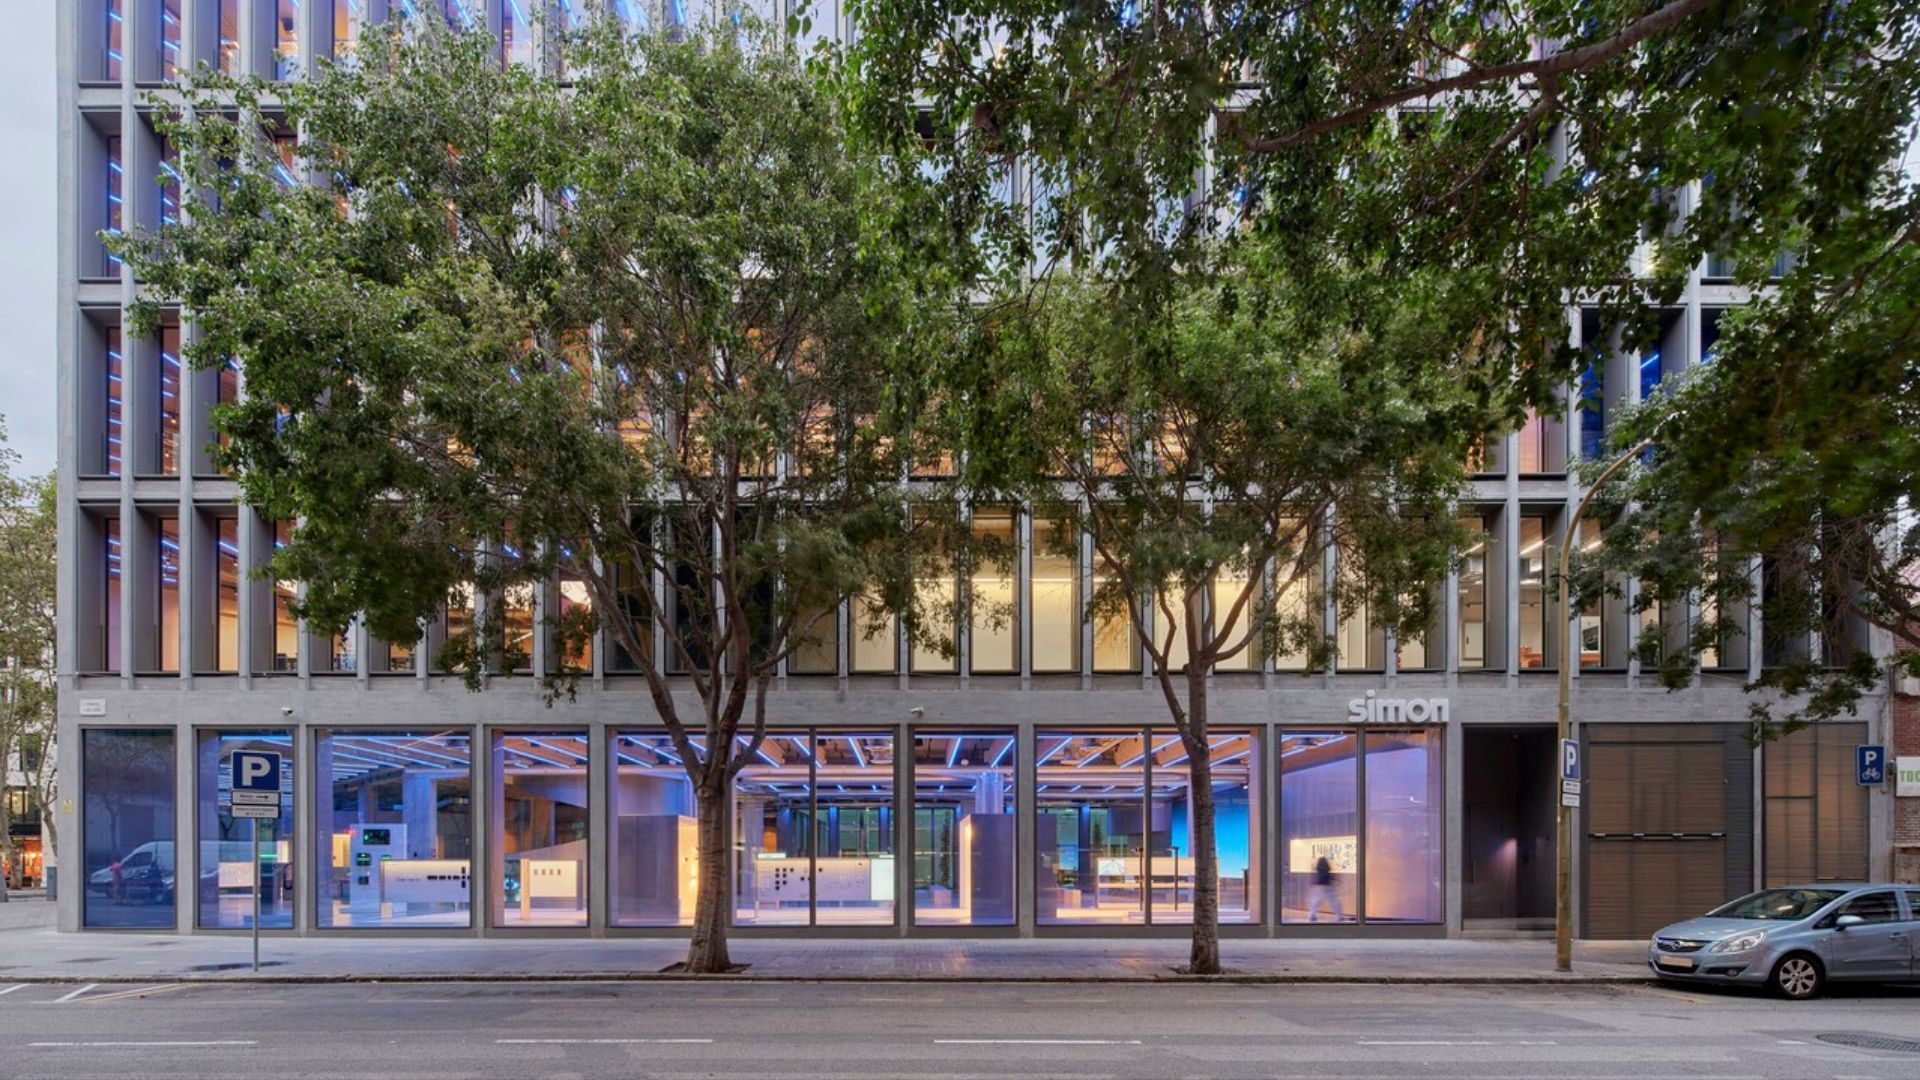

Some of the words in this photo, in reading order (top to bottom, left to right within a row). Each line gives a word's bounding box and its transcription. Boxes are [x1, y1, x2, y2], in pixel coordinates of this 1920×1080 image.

[1348, 689, 1449, 722] simon
[242, 756, 271, 786] P
[1566, 744, 1576, 775] P
[1865, 751, 1877, 766] P
